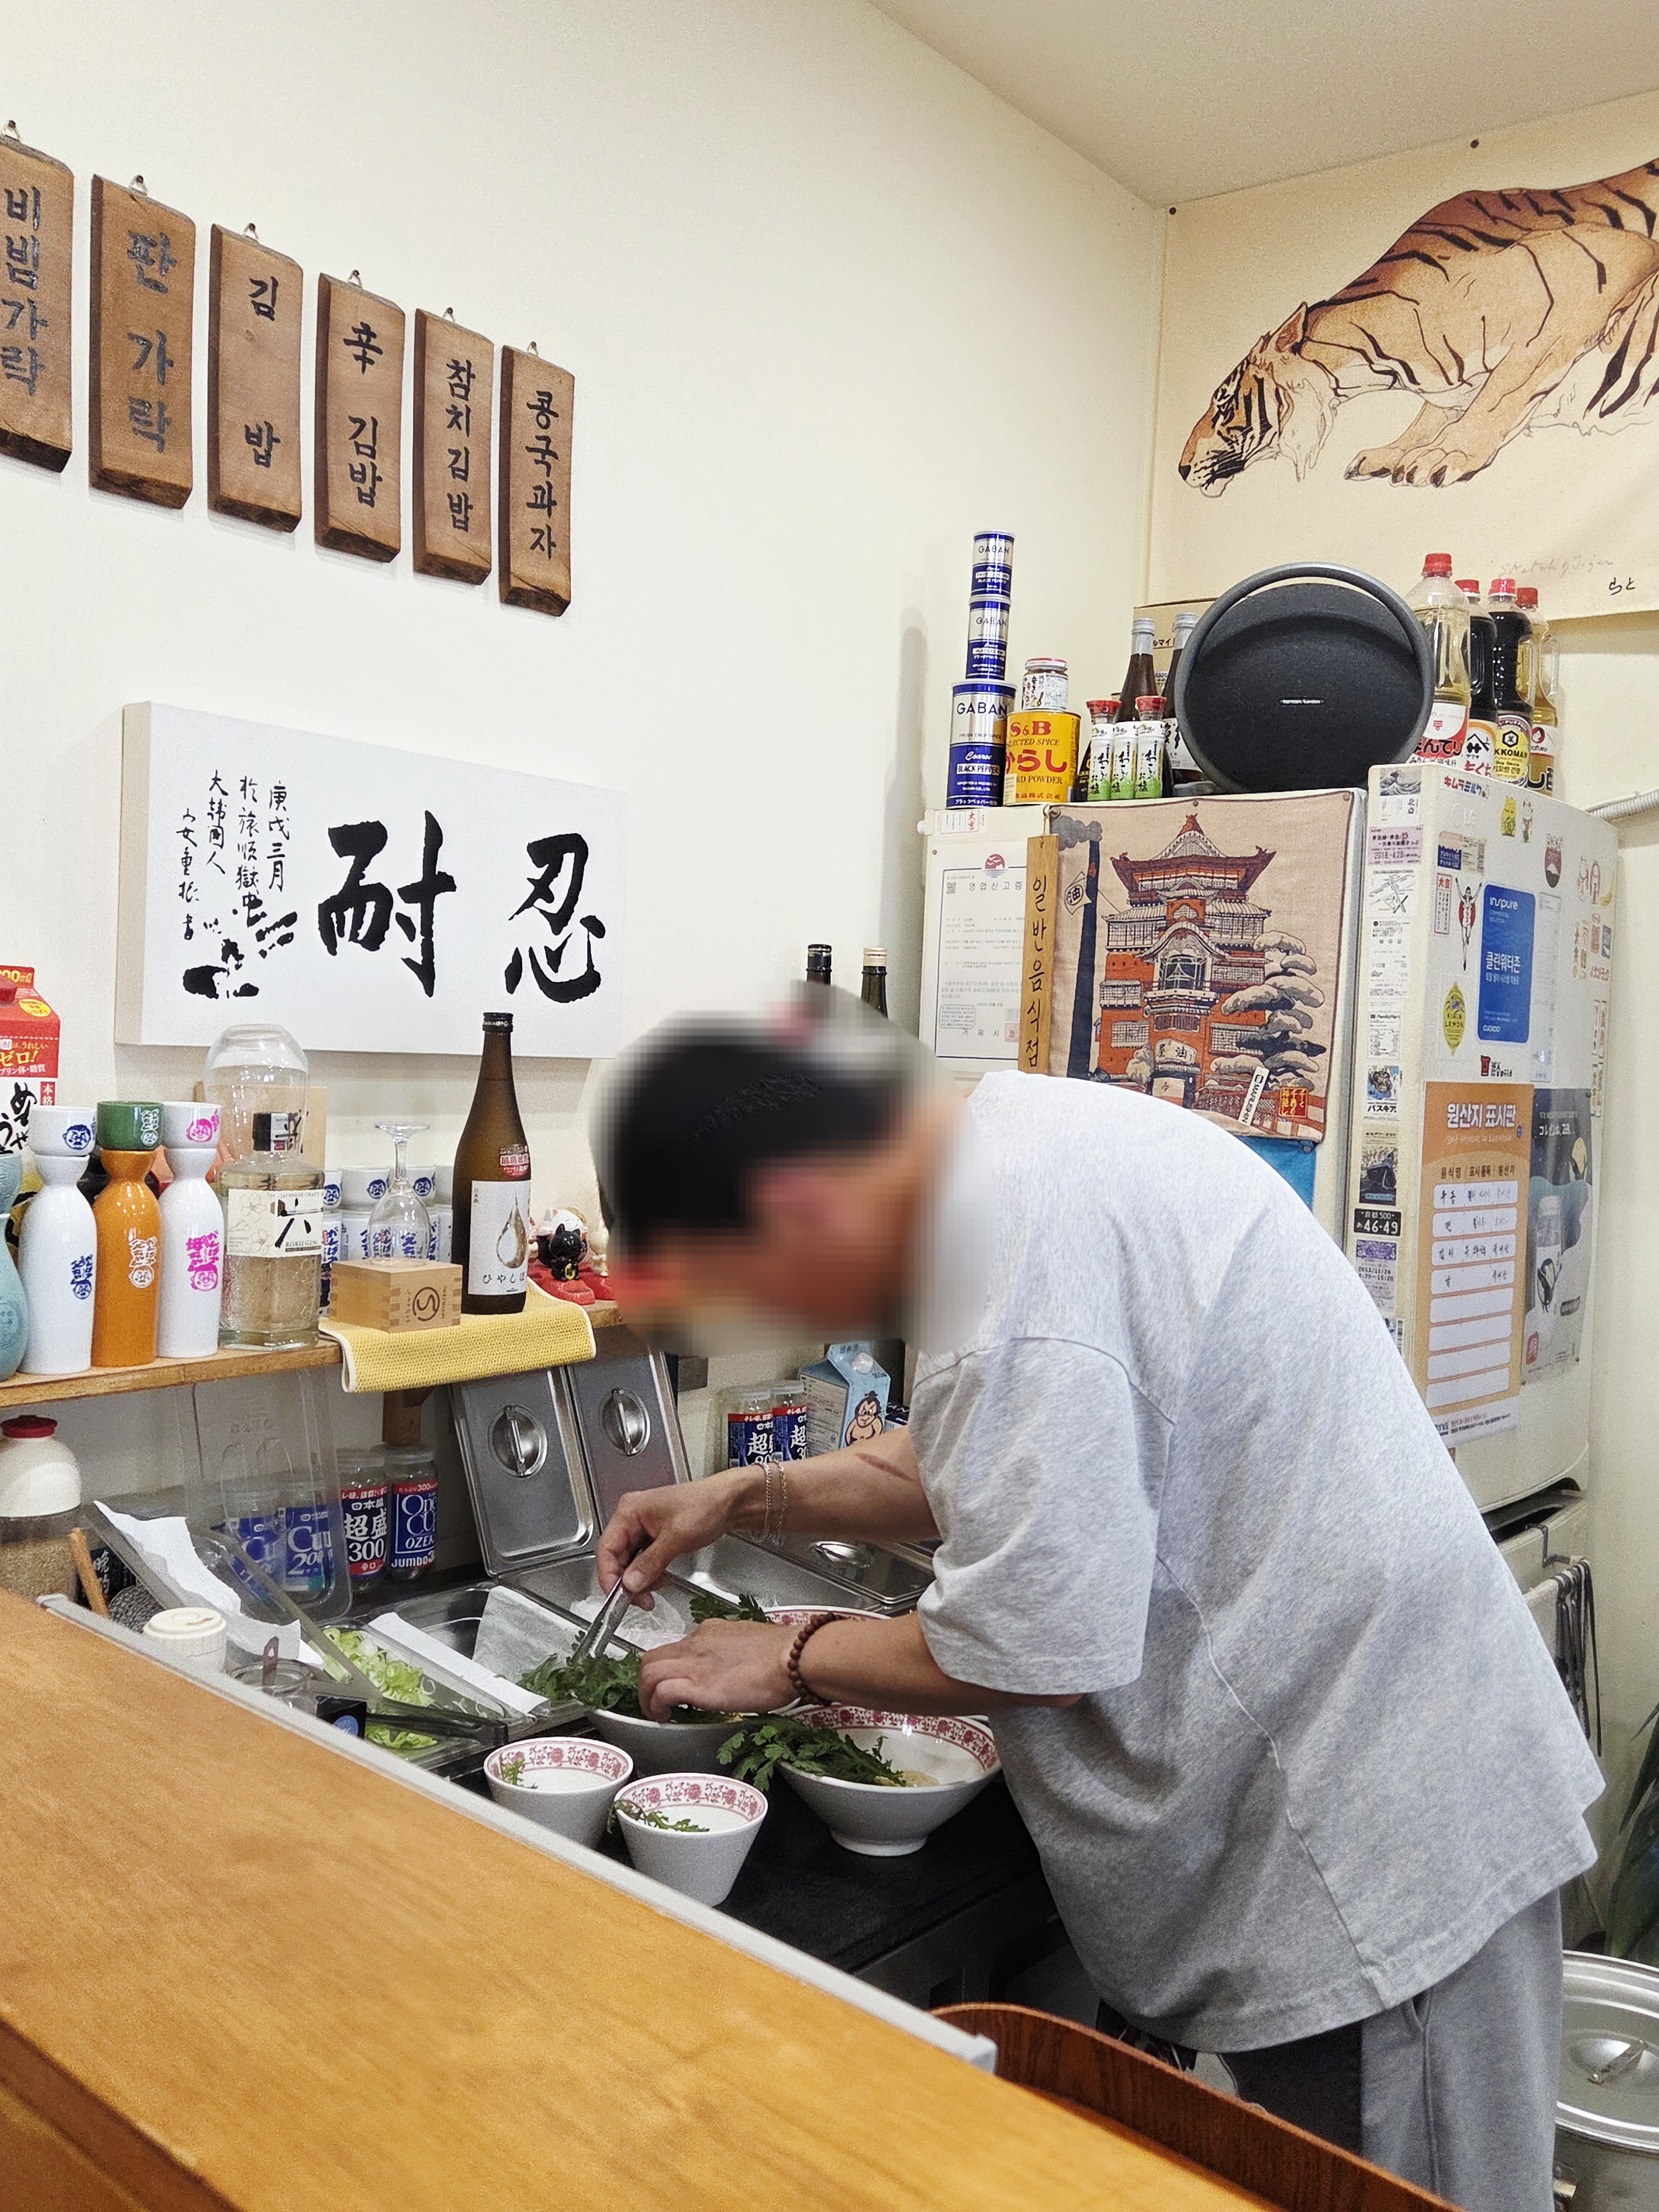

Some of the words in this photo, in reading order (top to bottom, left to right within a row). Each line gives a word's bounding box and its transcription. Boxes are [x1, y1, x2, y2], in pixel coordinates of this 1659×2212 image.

[445, 358, 476, 533] 참치김밥
[347, 415, 383, 508] 김밥
[526, 390, 559, 560] 콩국과자
[978, 545, 1009, 555] GABAN
[976, 617, 1007, 628] GABAN
[957, 702, 1007, 715] GABAN
[1010, 721, 1051, 737] S&B
[1494, 748, 1528, 759] KKOMAN
[958, 764, 975, 773] BLACK
[977, 764, 999, 773] PEPPER
[1028, 775, 1063, 784] POWDER
[969, 881, 1022, 891] 영업신고증
[1068, 888, 1084, 903] 油
[1485, 951, 1521, 973] 클린워터존
[1025, 874, 1047, 1067] 일반음식점
[1447, 1103, 1483, 1128] 원산지
[1485, 1104, 1517, 1128] 표시판
[1441, 1167, 1462, 1179] 음식명
[401, 1494, 437, 1515] One
[344, 1508, 387, 1541] 超盛
[348, 1538, 384, 1562] 300
[361, 1562, 376, 1571] 辛口
